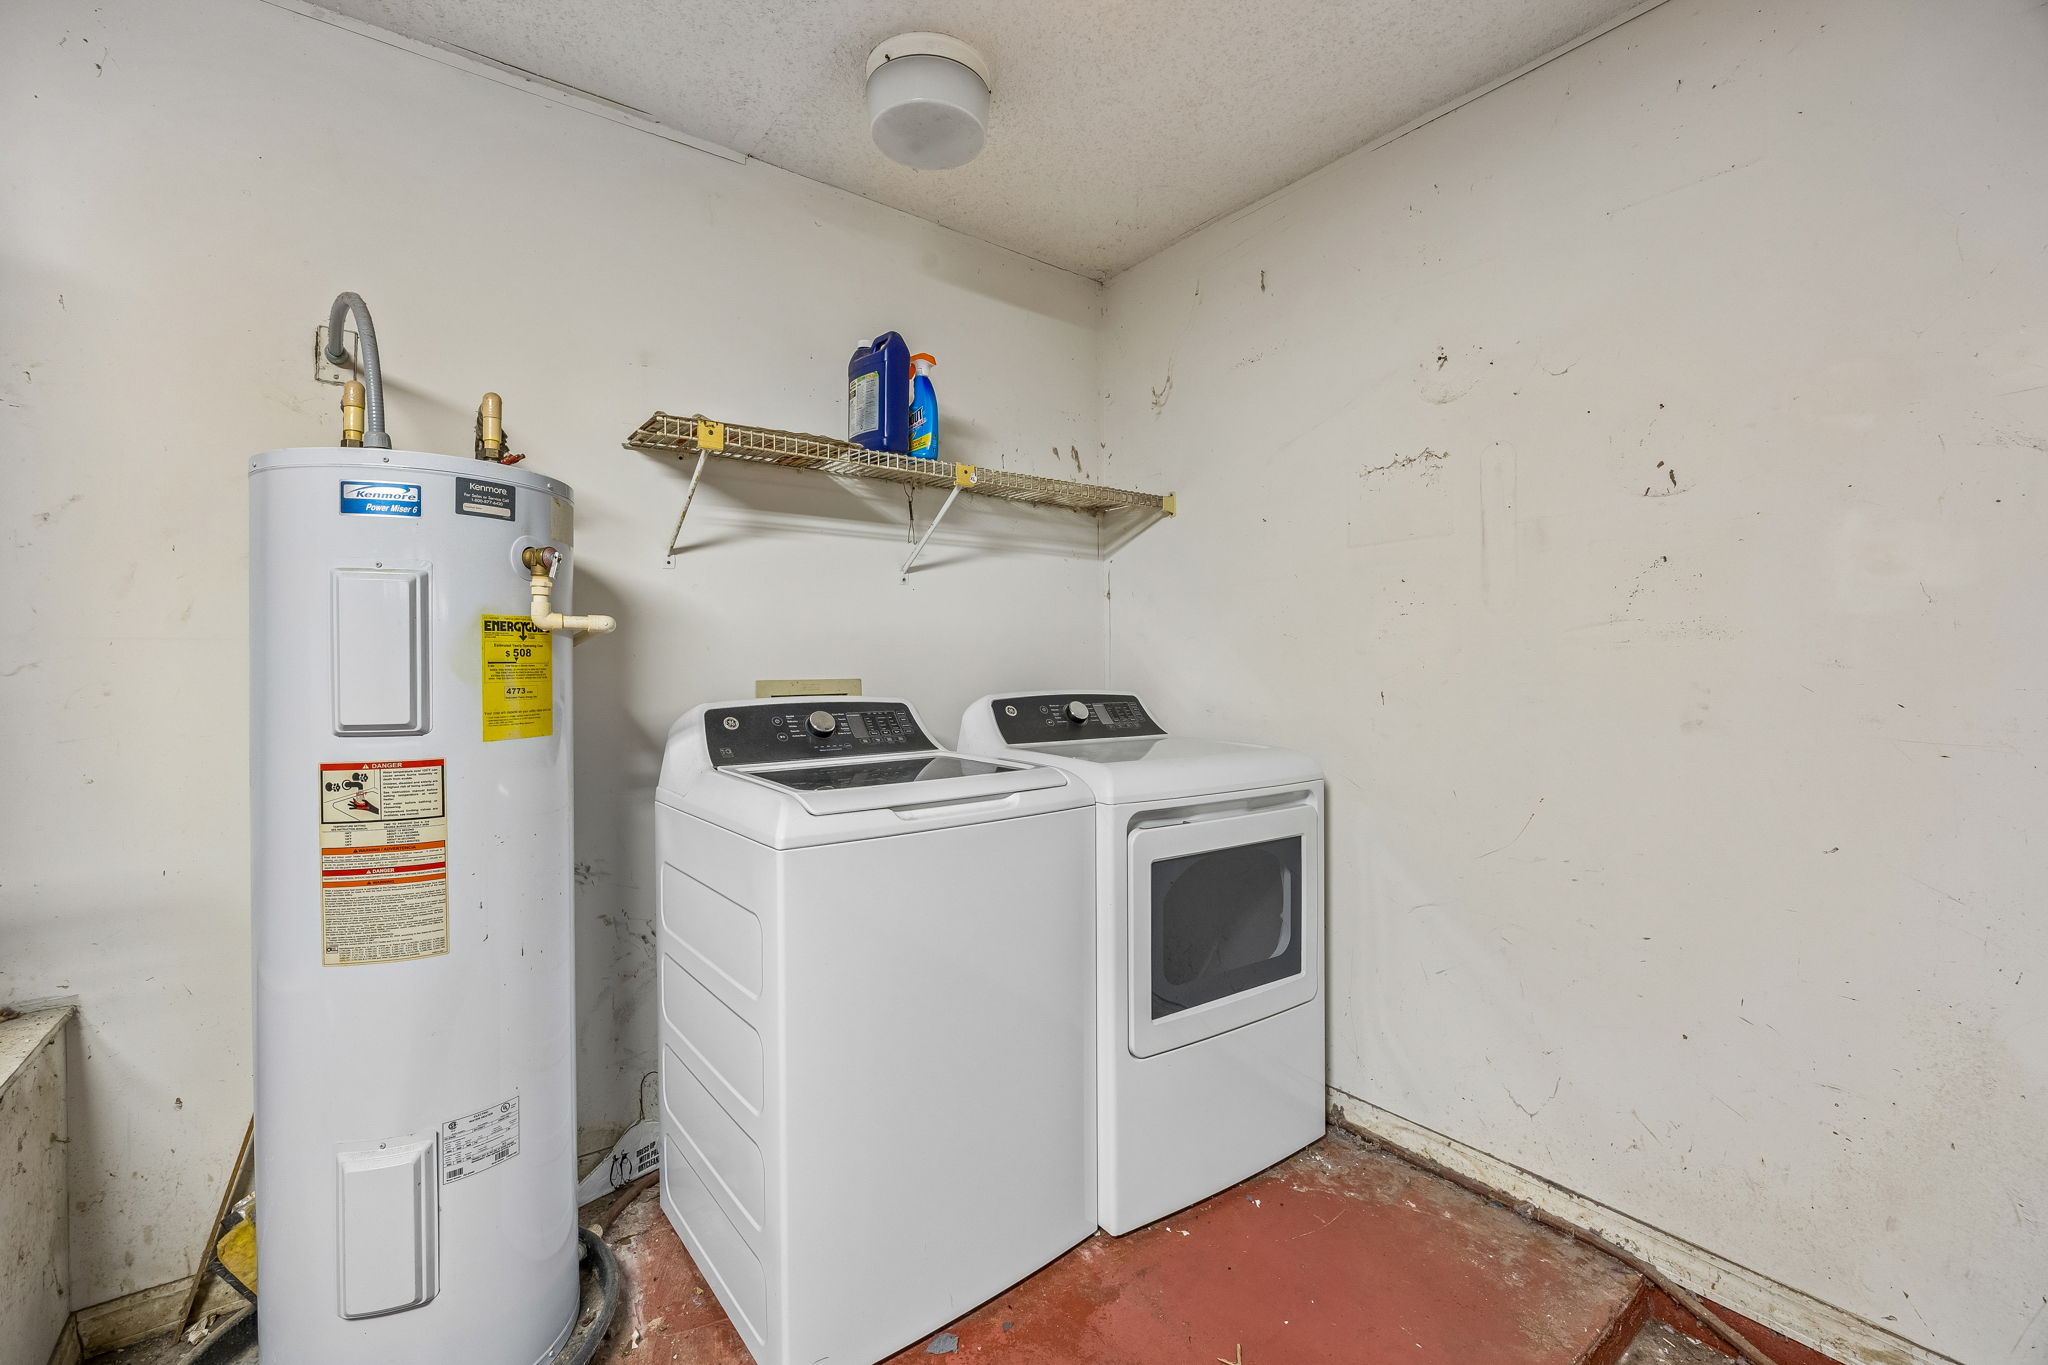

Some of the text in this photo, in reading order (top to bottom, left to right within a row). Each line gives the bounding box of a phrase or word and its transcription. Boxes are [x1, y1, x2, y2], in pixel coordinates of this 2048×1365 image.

[470, 483, 507, 495] Kenmore
[356, 490, 416, 500] Kenmore
[366, 503, 389, 511] Power
[390, 504, 412, 513] Miser
[484, 620, 550, 633] ENERGYGU
[513, 648, 532, 657] 508
[506, 687, 526, 695] 4773
